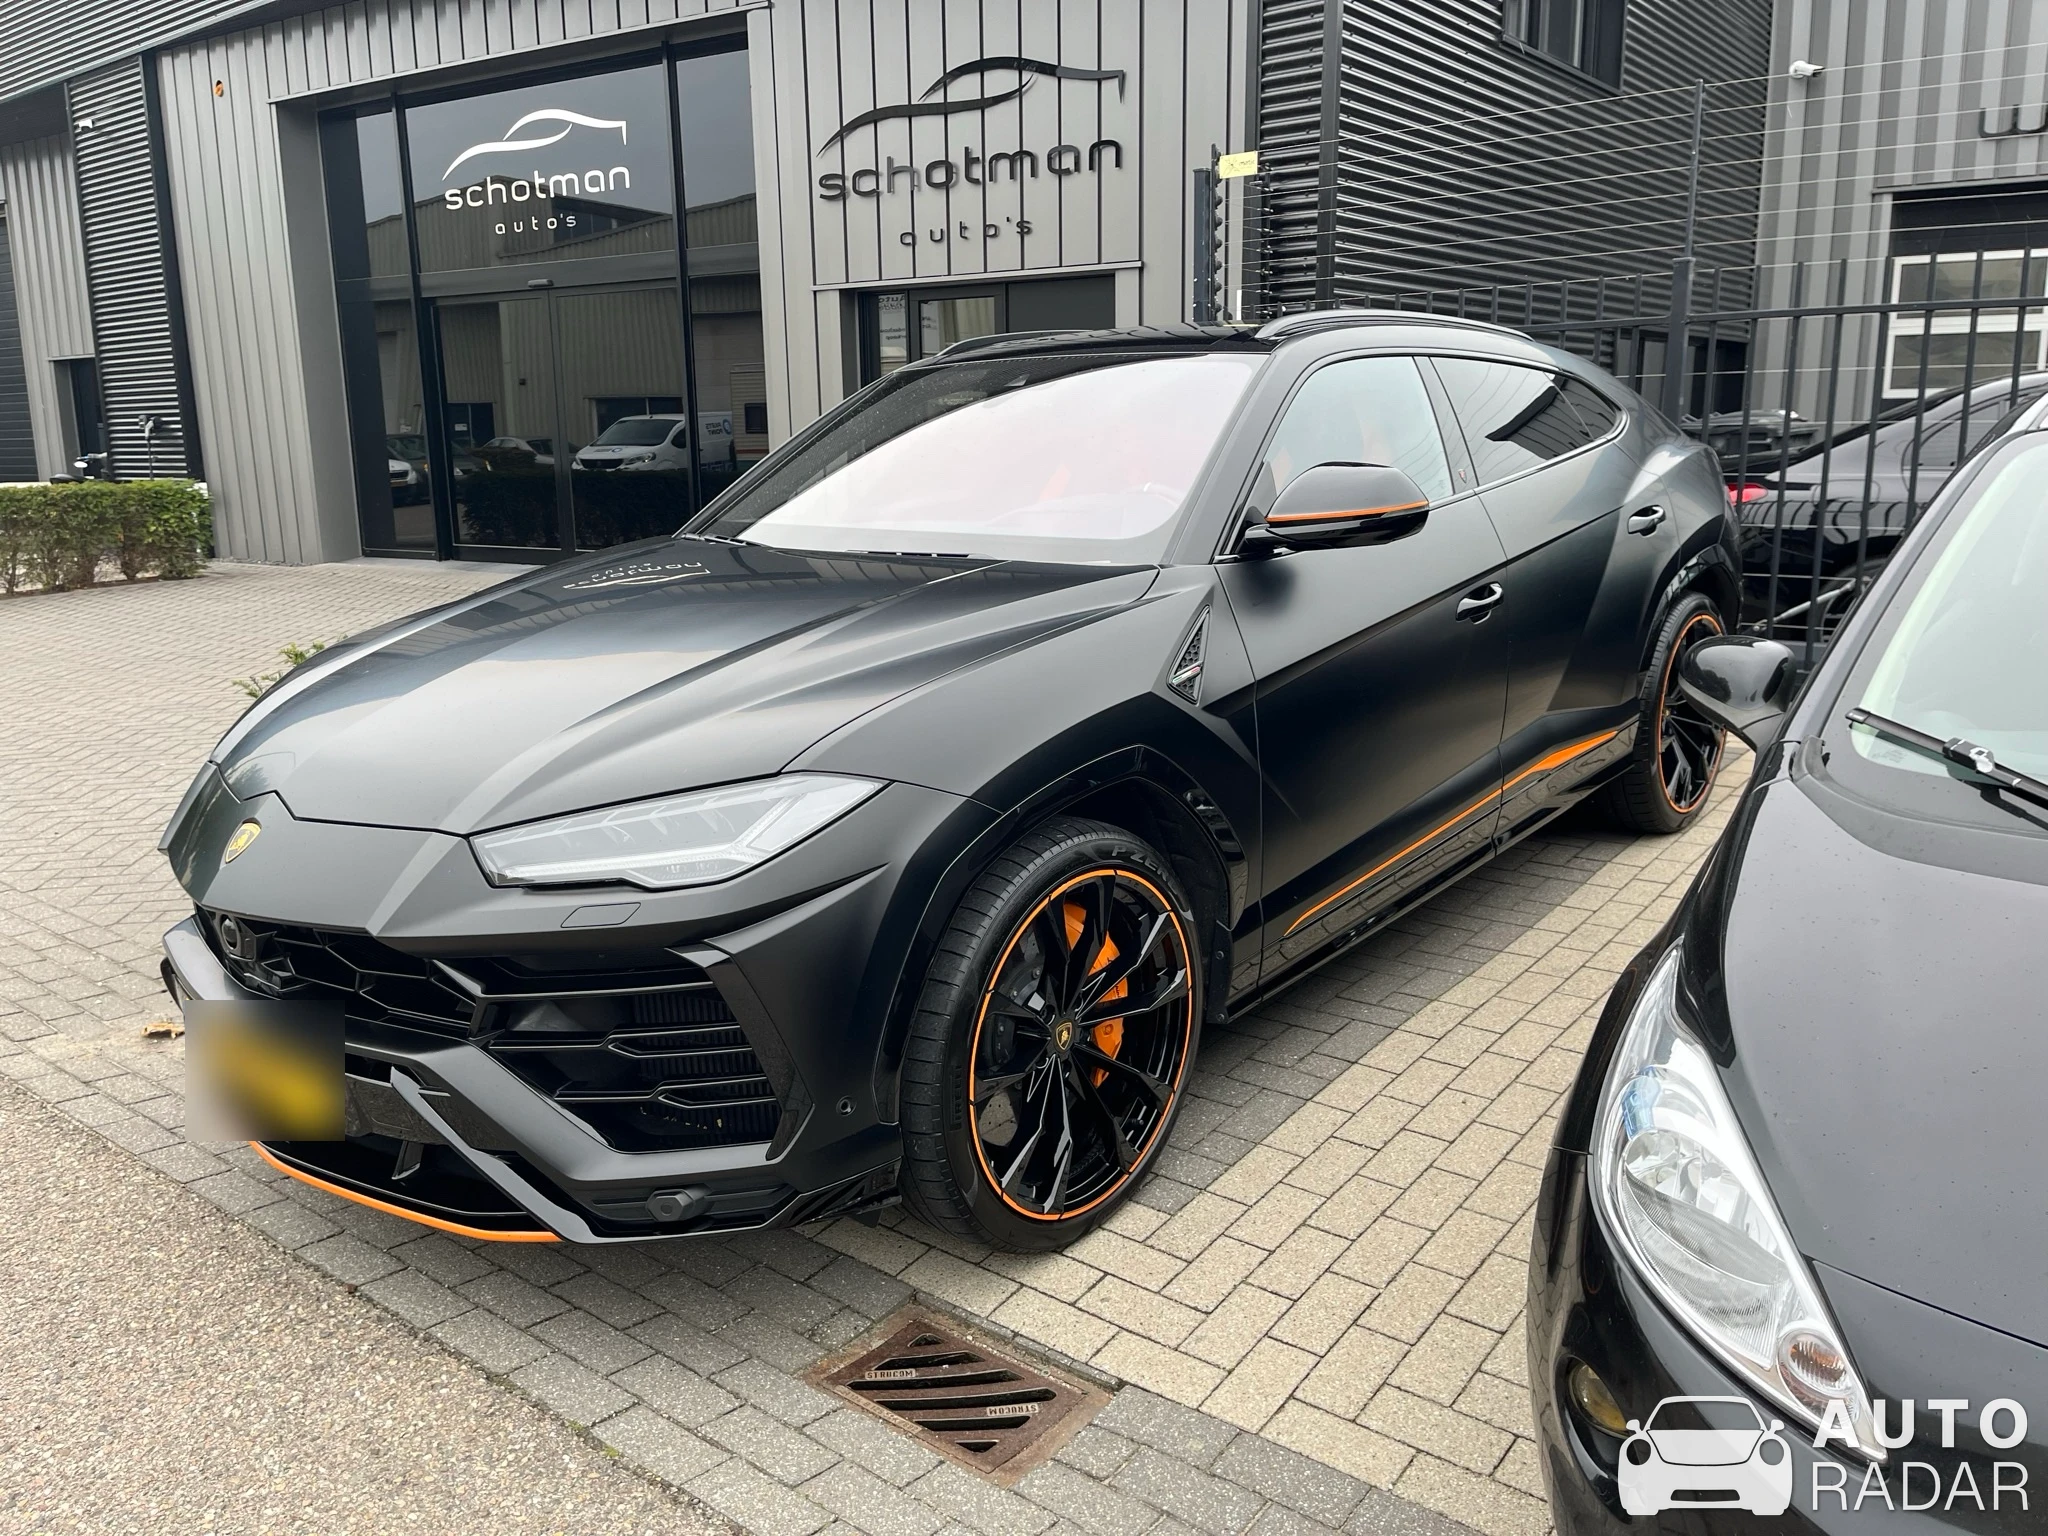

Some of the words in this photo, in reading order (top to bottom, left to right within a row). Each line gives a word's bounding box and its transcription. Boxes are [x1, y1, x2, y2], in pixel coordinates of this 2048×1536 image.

[819, 139, 1123, 201] schotman
[444, 166, 631, 210] schotman
[495, 214, 577, 235] auto's
[900, 216, 1033, 246] auto's
[866, 1370, 913, 1379] STRUCOM
[989, 1404, 1037, 1415] STRUCOM
